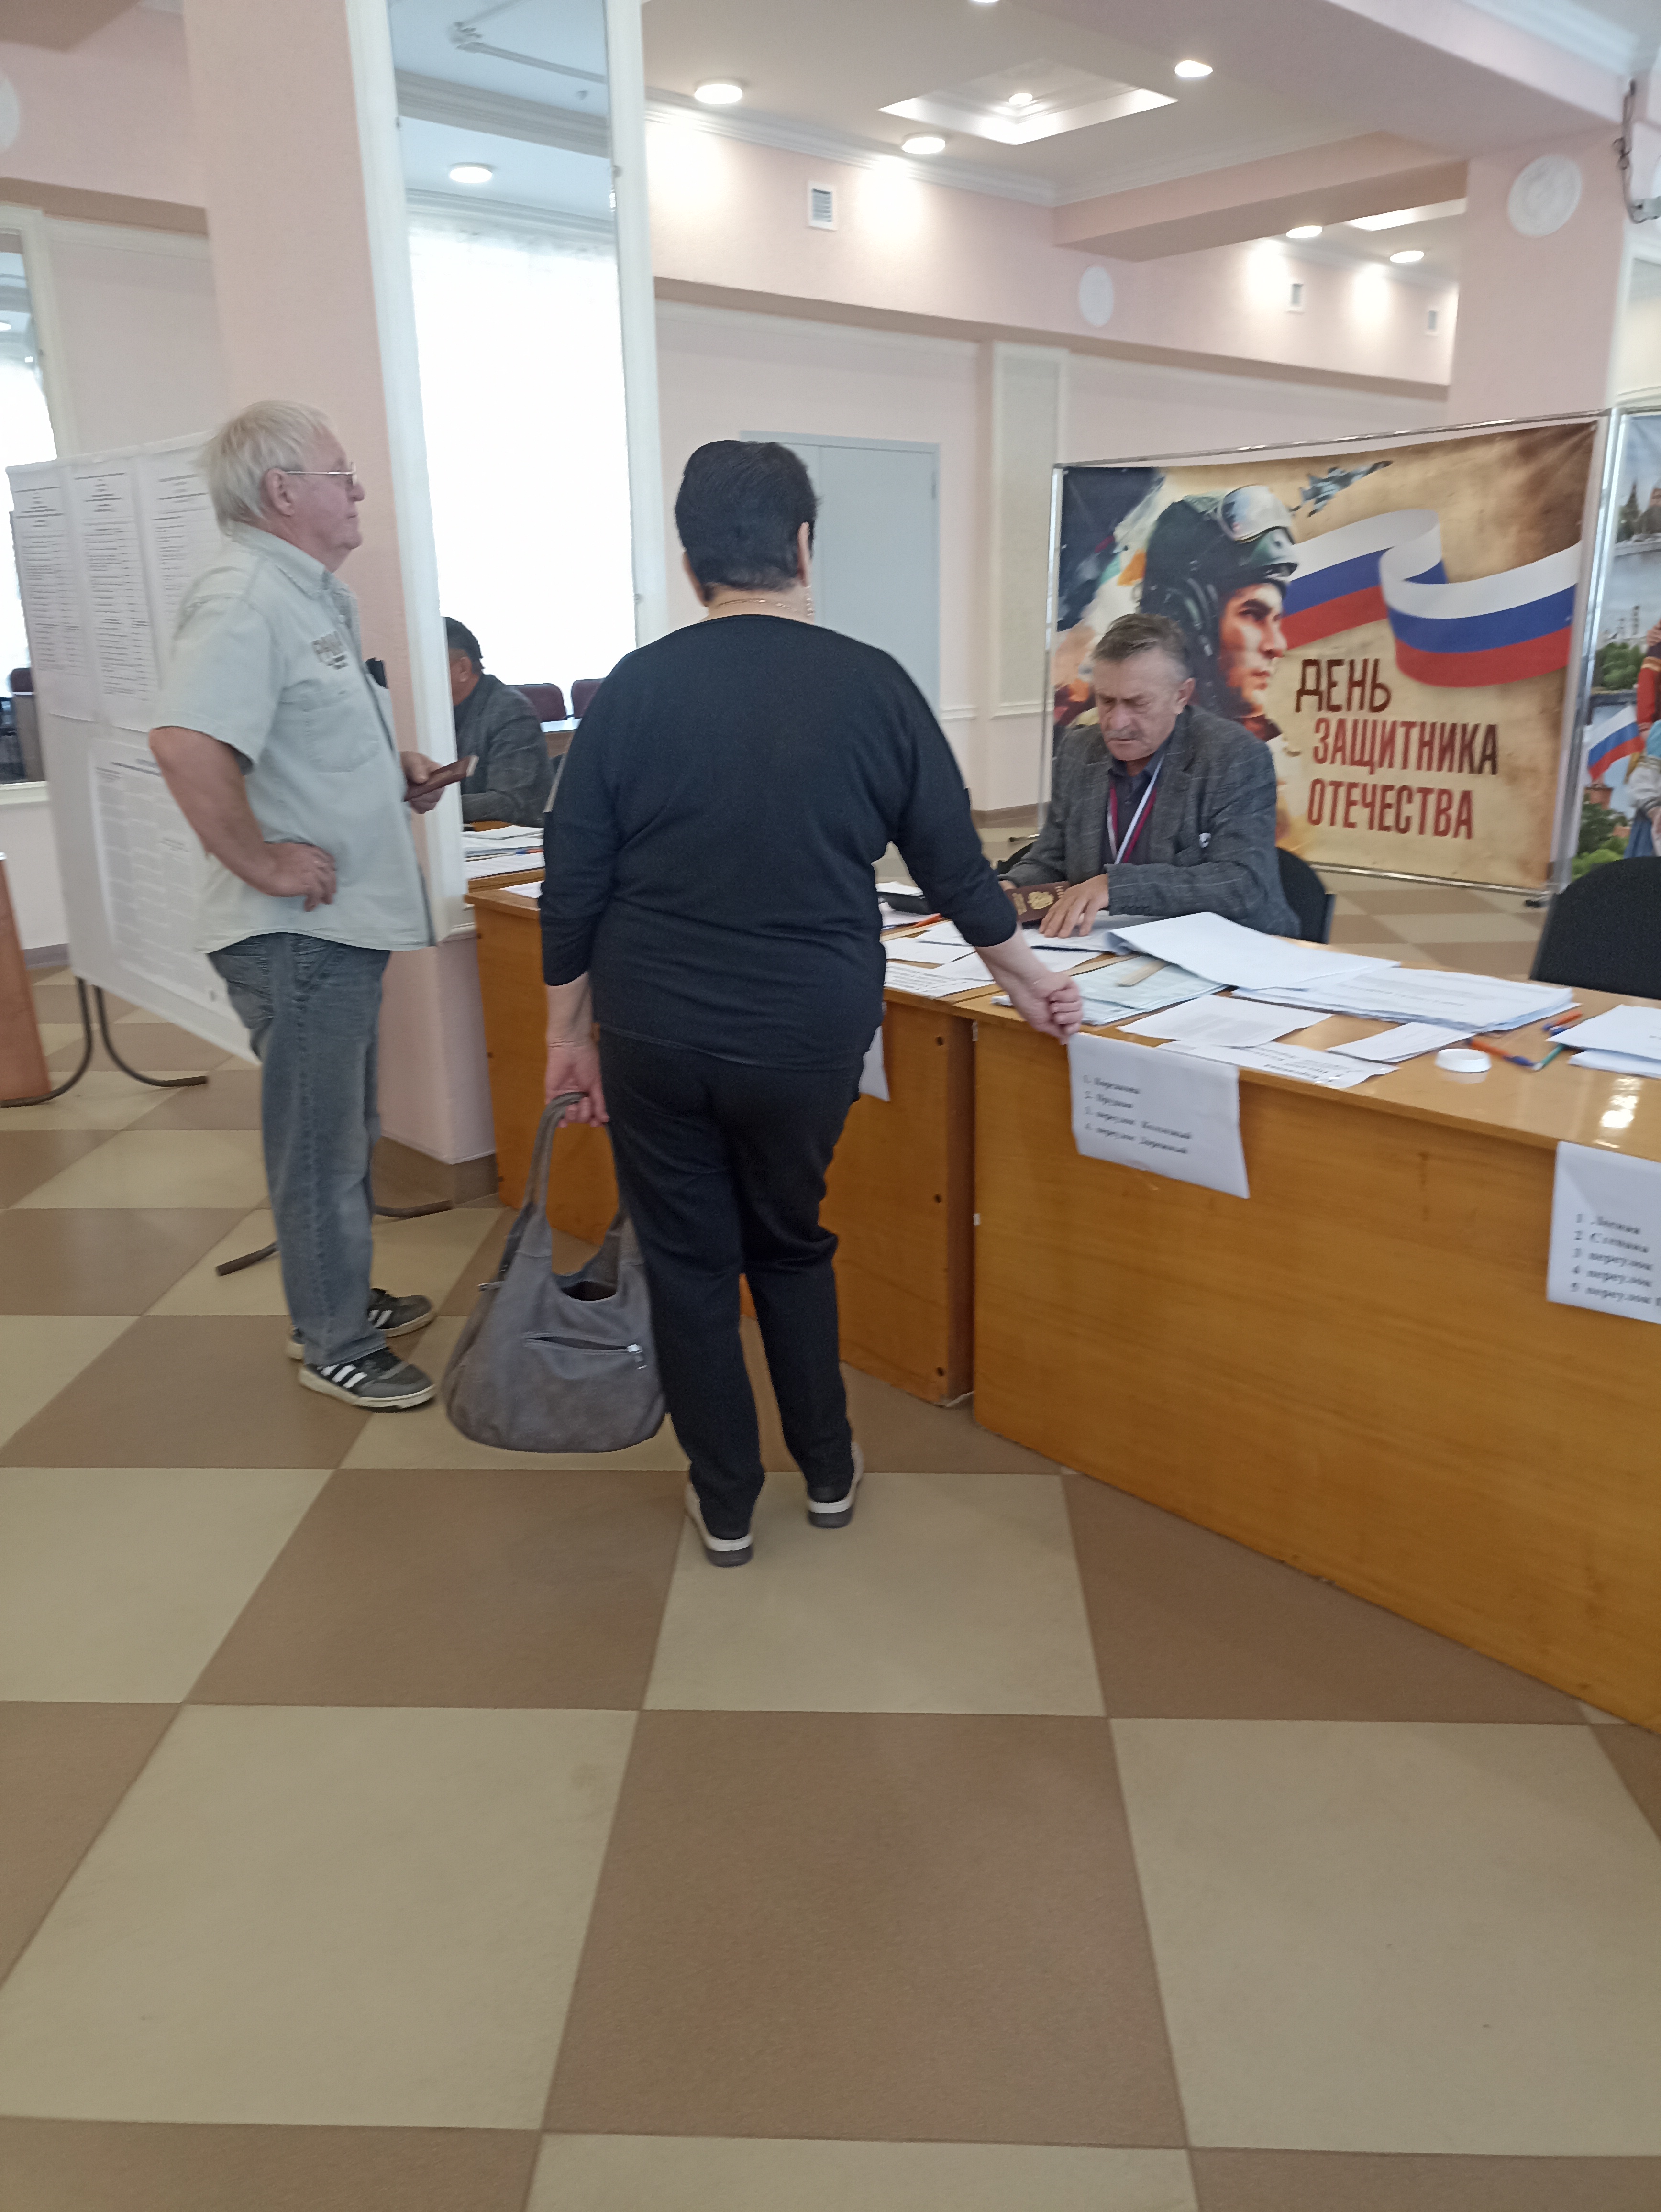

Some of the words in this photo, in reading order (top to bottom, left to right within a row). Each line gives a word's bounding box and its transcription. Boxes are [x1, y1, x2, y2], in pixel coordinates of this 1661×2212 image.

[1295, 658, 1392, 713] ДЕНЬ
[1313, 717, 1498, 775] ЗАЩИТНИКА
[1307, 778, 1473, 840] ОТЕЧЕСТВА
[1586, 1270, 1652, 1287] переулок
[1588, 1252, 1653, 1271] переулок
[1584, 1287, 1650, 1304] переулок
